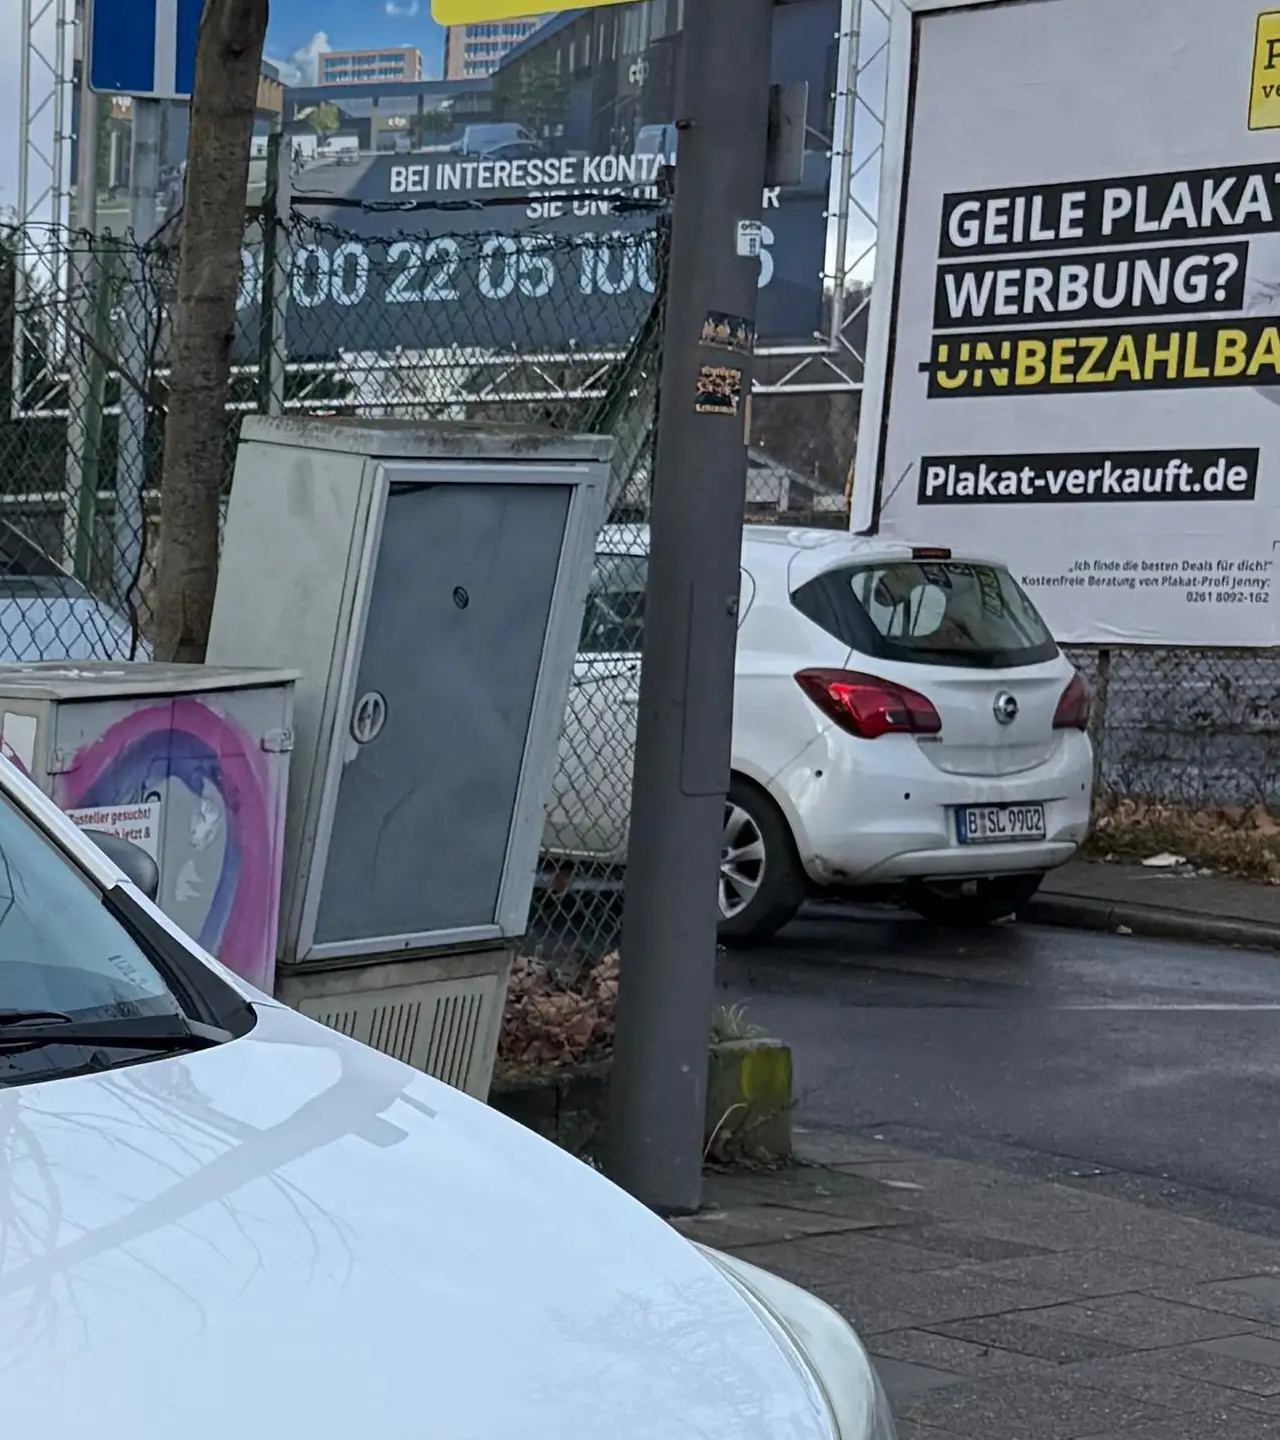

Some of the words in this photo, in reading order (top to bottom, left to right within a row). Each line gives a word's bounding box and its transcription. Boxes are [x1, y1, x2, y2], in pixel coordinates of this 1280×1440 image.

[390, 166, 429, 193] BEI
[436, 156, 578, 190] INTERESSE
[583, 152, 676, 183] KONTA
[948, 191, 1087, 248] GEILE
[1101, 172, 1280, 237] PLAKA
[385, 240, 461, 303] 22
[944, 252, 1239, 319] WERBUNG?
[936, 326, 1280, 389] UNBEZAHLBA
[925, 457, 1249, 497] Plakat-verkauft.de
[1021, 575, 1086, 588] Kostenfreie
[1088, 576, 1136, 590] Beratung
[1139, 578, 1158, 588] von
[1161, 574, 1230, 588] Plakat-Profi
[1092, 559, 1121, 573] finde
[1122, 559, 1139, 572] die
[1141, 559, 1179, 572] besten
[1181, 560, 1213, 572] Deals
[1186, 592, 1212, 604] 0261
[111, 806, 151, 826] gesucht!
[968, 811, 978, 834] B
[987, 810, 1006, 833] SL
[1008, 809, 1041, 832] 9902
